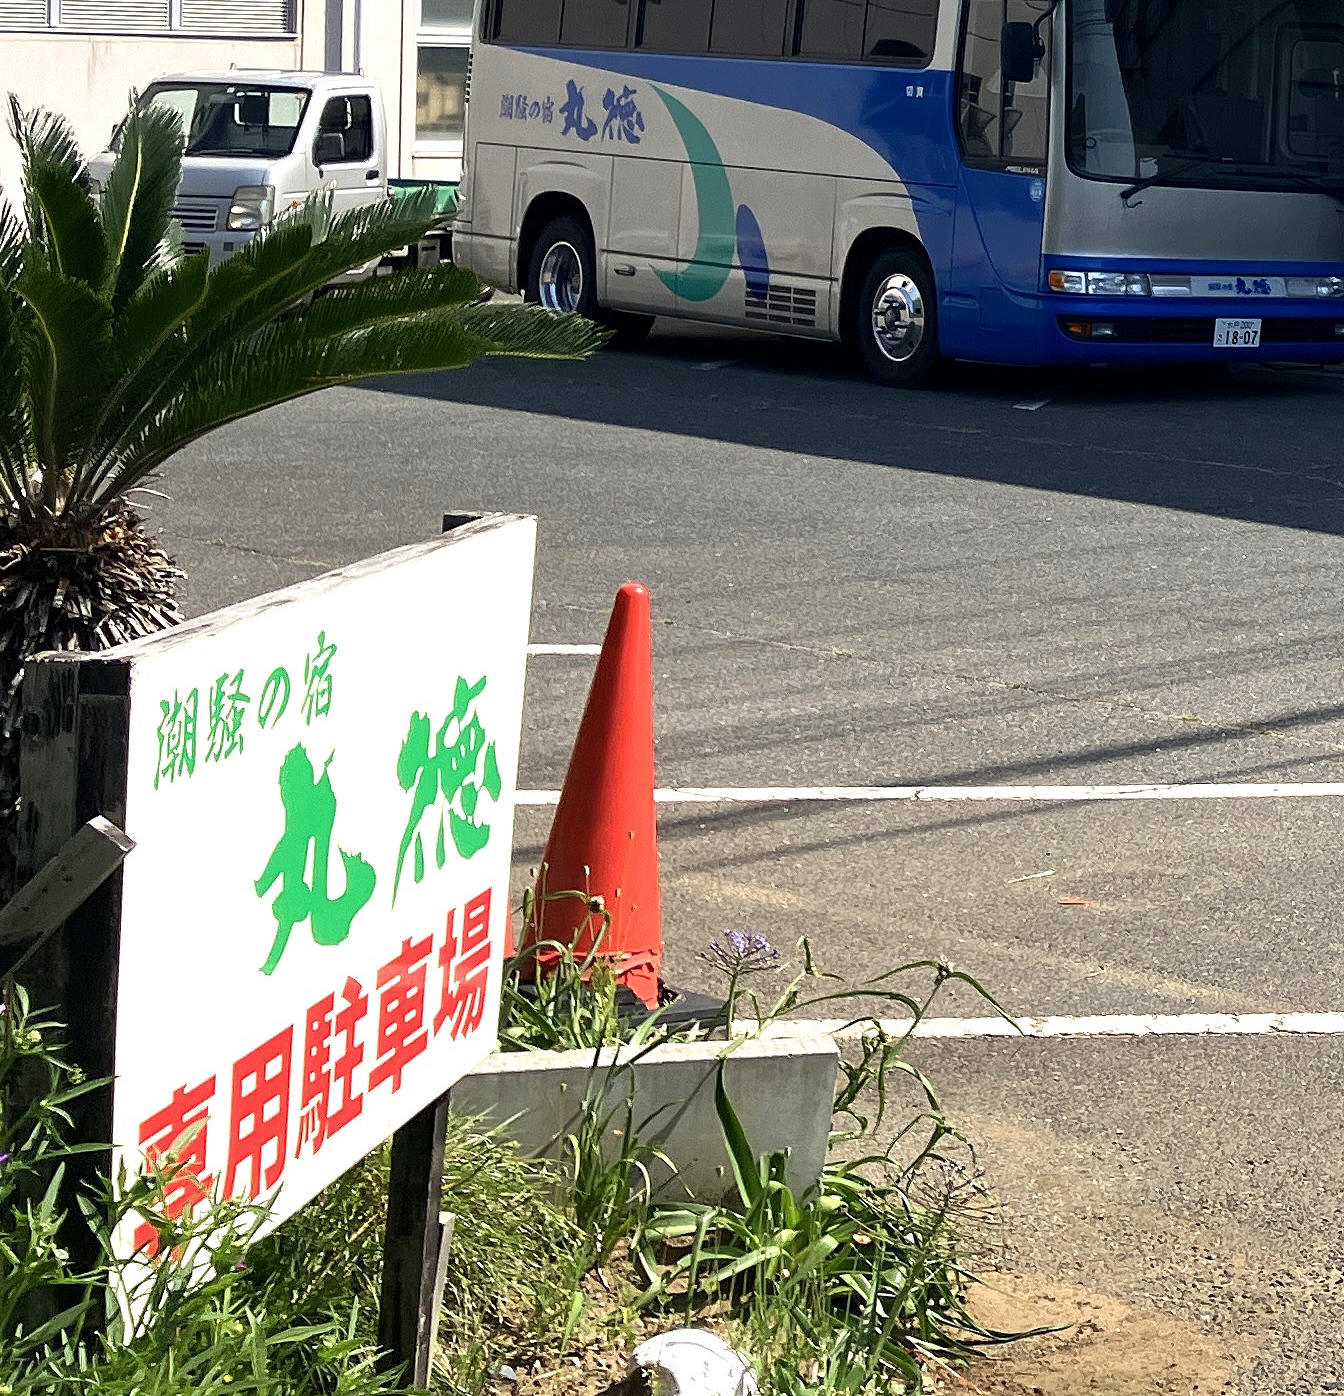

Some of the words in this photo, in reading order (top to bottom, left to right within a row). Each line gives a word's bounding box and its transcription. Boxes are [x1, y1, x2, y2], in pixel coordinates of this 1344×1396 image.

[559, 79, 645, 144] 丸徳
[1225, 330, 1259, 345] 18-07
[154, 630, 338, 790] 潮騒の宿
[254, 676, 501, 976] 丸徳
[133, 887, 493, 1264] 専用駐車場
